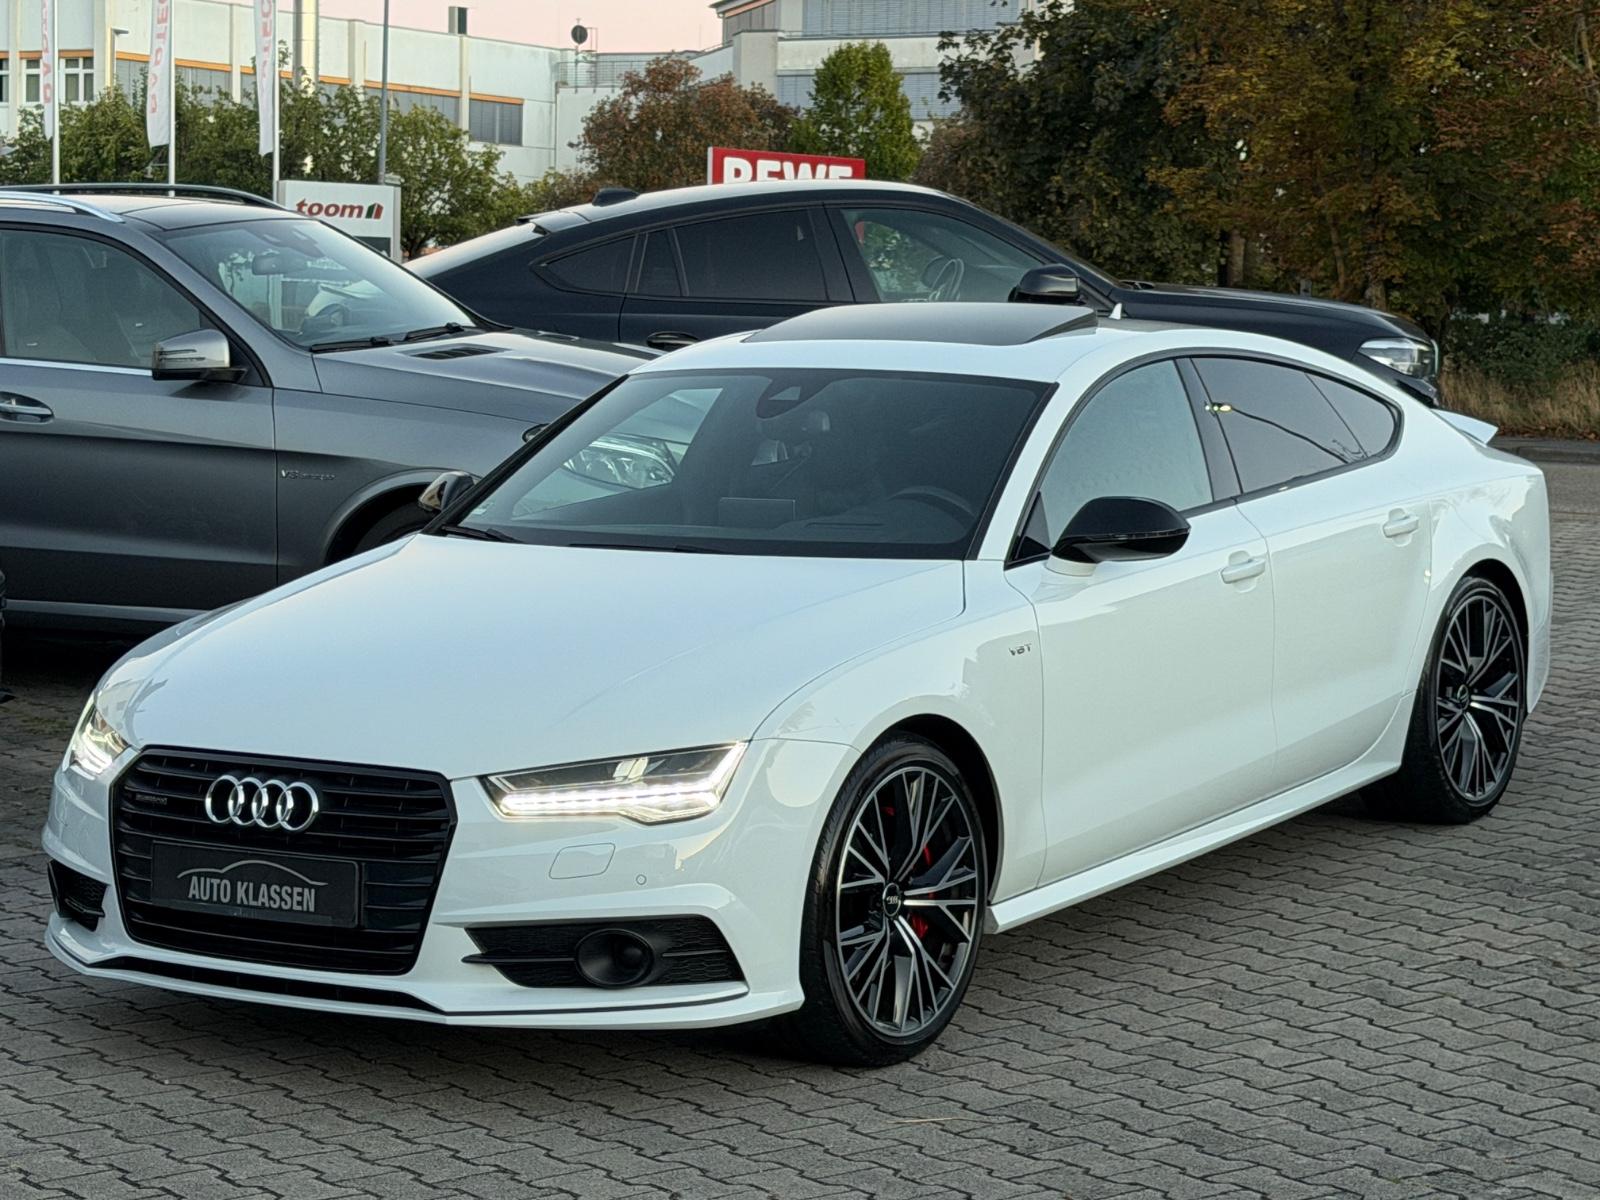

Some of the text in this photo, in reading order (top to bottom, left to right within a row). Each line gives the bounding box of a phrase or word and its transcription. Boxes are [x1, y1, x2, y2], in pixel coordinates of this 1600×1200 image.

[296, 198, 364, 218] toom
[188, 875, 316, 913] AUTO KLASSEN
